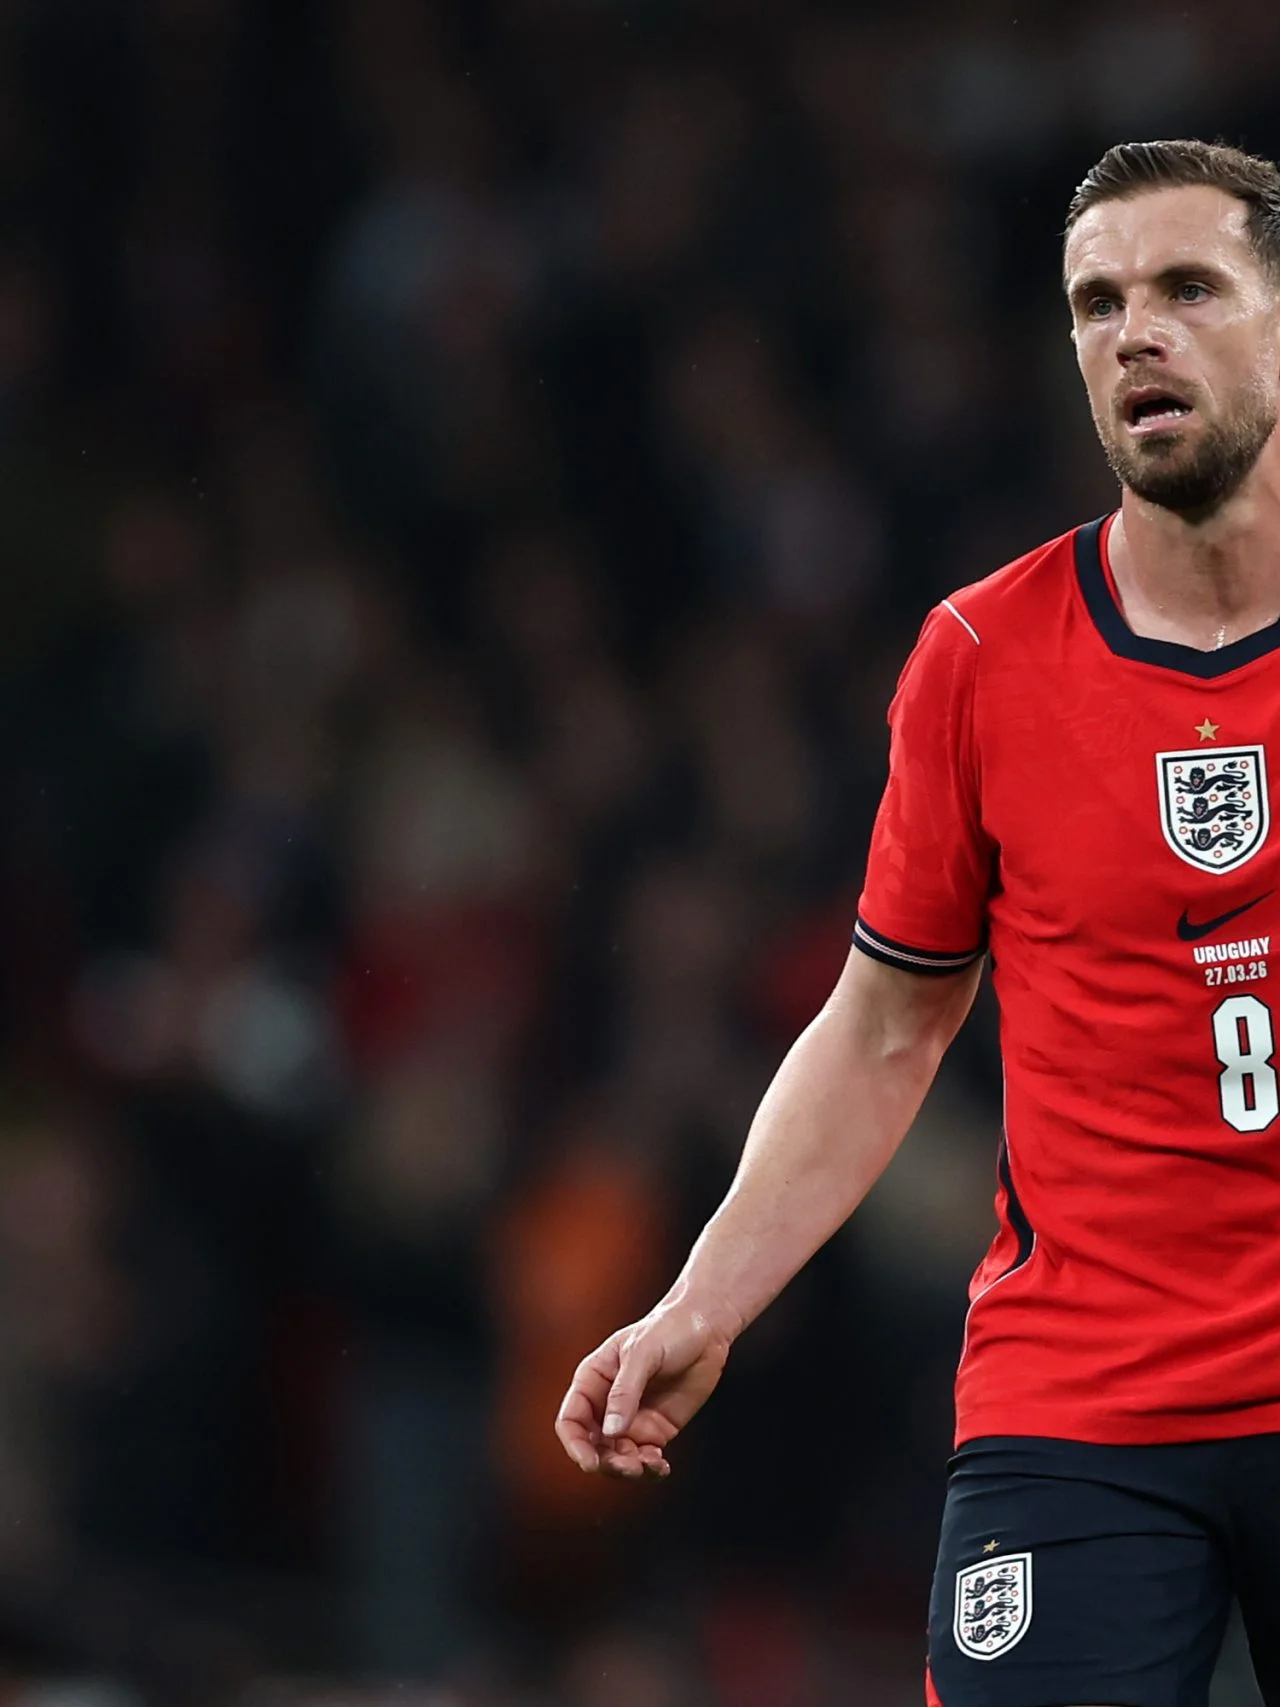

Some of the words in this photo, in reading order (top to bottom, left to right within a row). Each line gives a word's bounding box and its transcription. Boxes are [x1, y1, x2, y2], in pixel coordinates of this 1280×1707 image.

[1193, 937, 1270, 964] URUGUAY
[1205, 961, 1267, 986] 27.03.26
[1212, 994, 1280, 1133] 8
